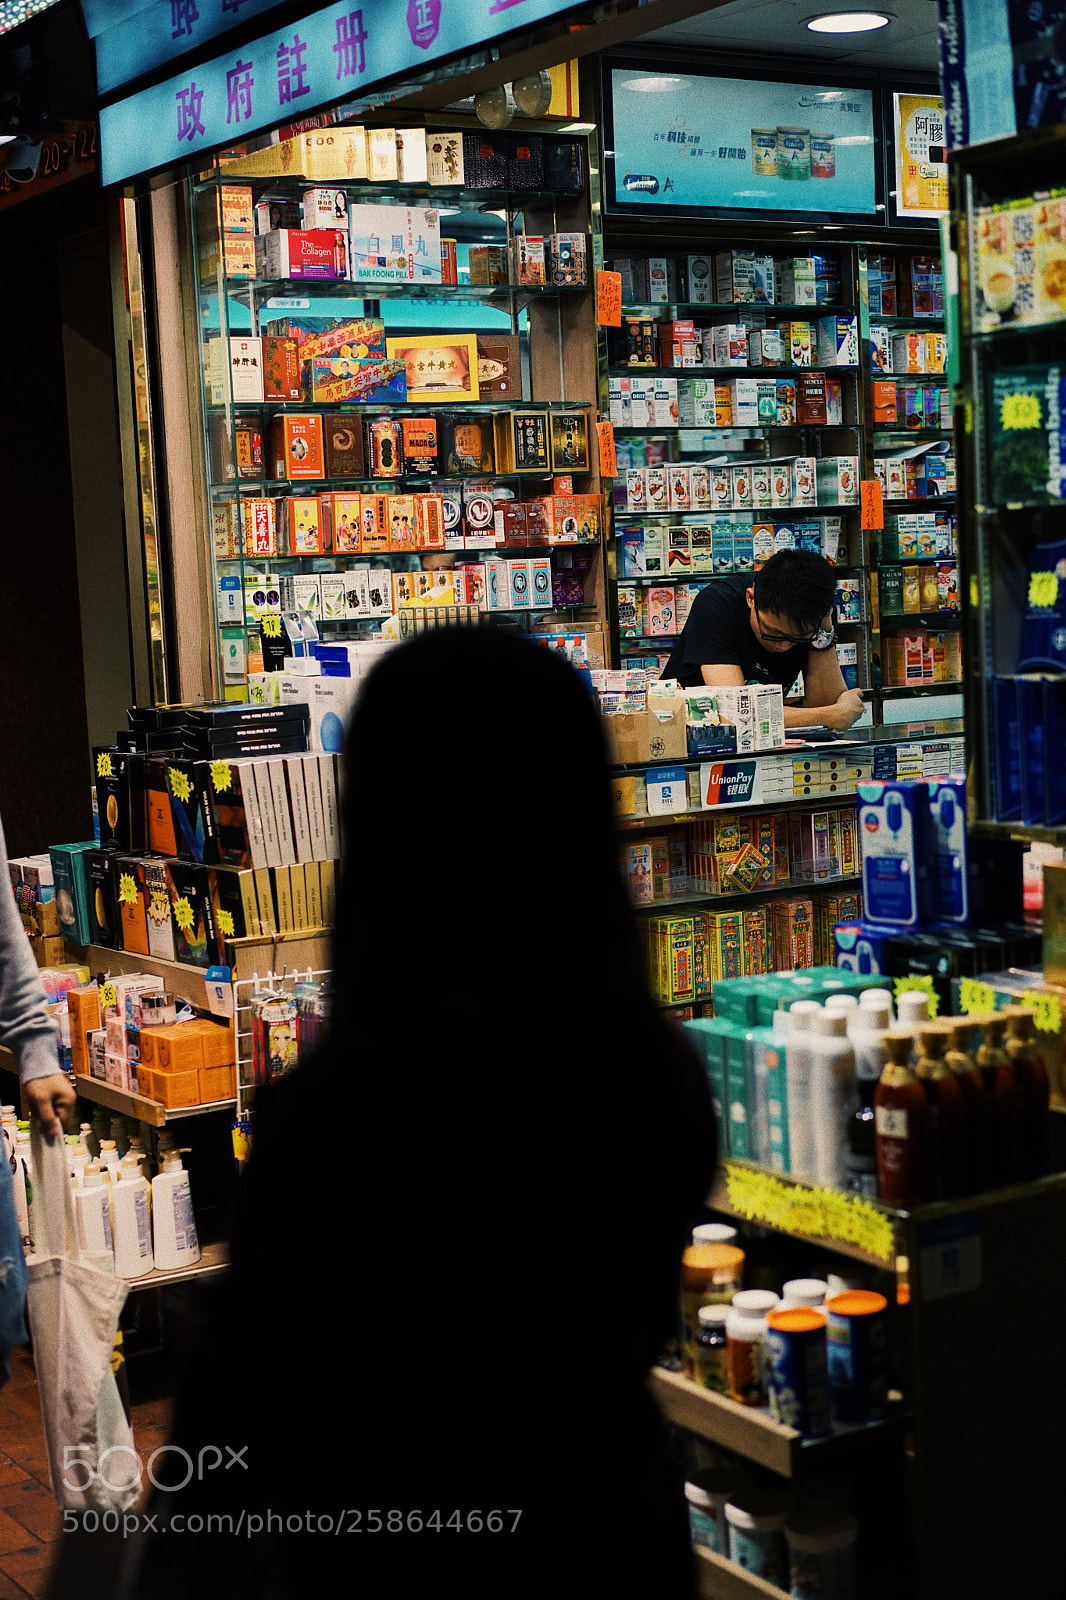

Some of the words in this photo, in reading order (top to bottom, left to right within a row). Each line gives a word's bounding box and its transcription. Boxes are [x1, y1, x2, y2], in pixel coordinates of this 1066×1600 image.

[301, 240, 314, 248] The
[301, 247, 331, 257] Collagen
[359, 269, 371, 277] BAK
[372, 270, 395, 278] FOONG
[711, 772, 753, 785] UnionPay
